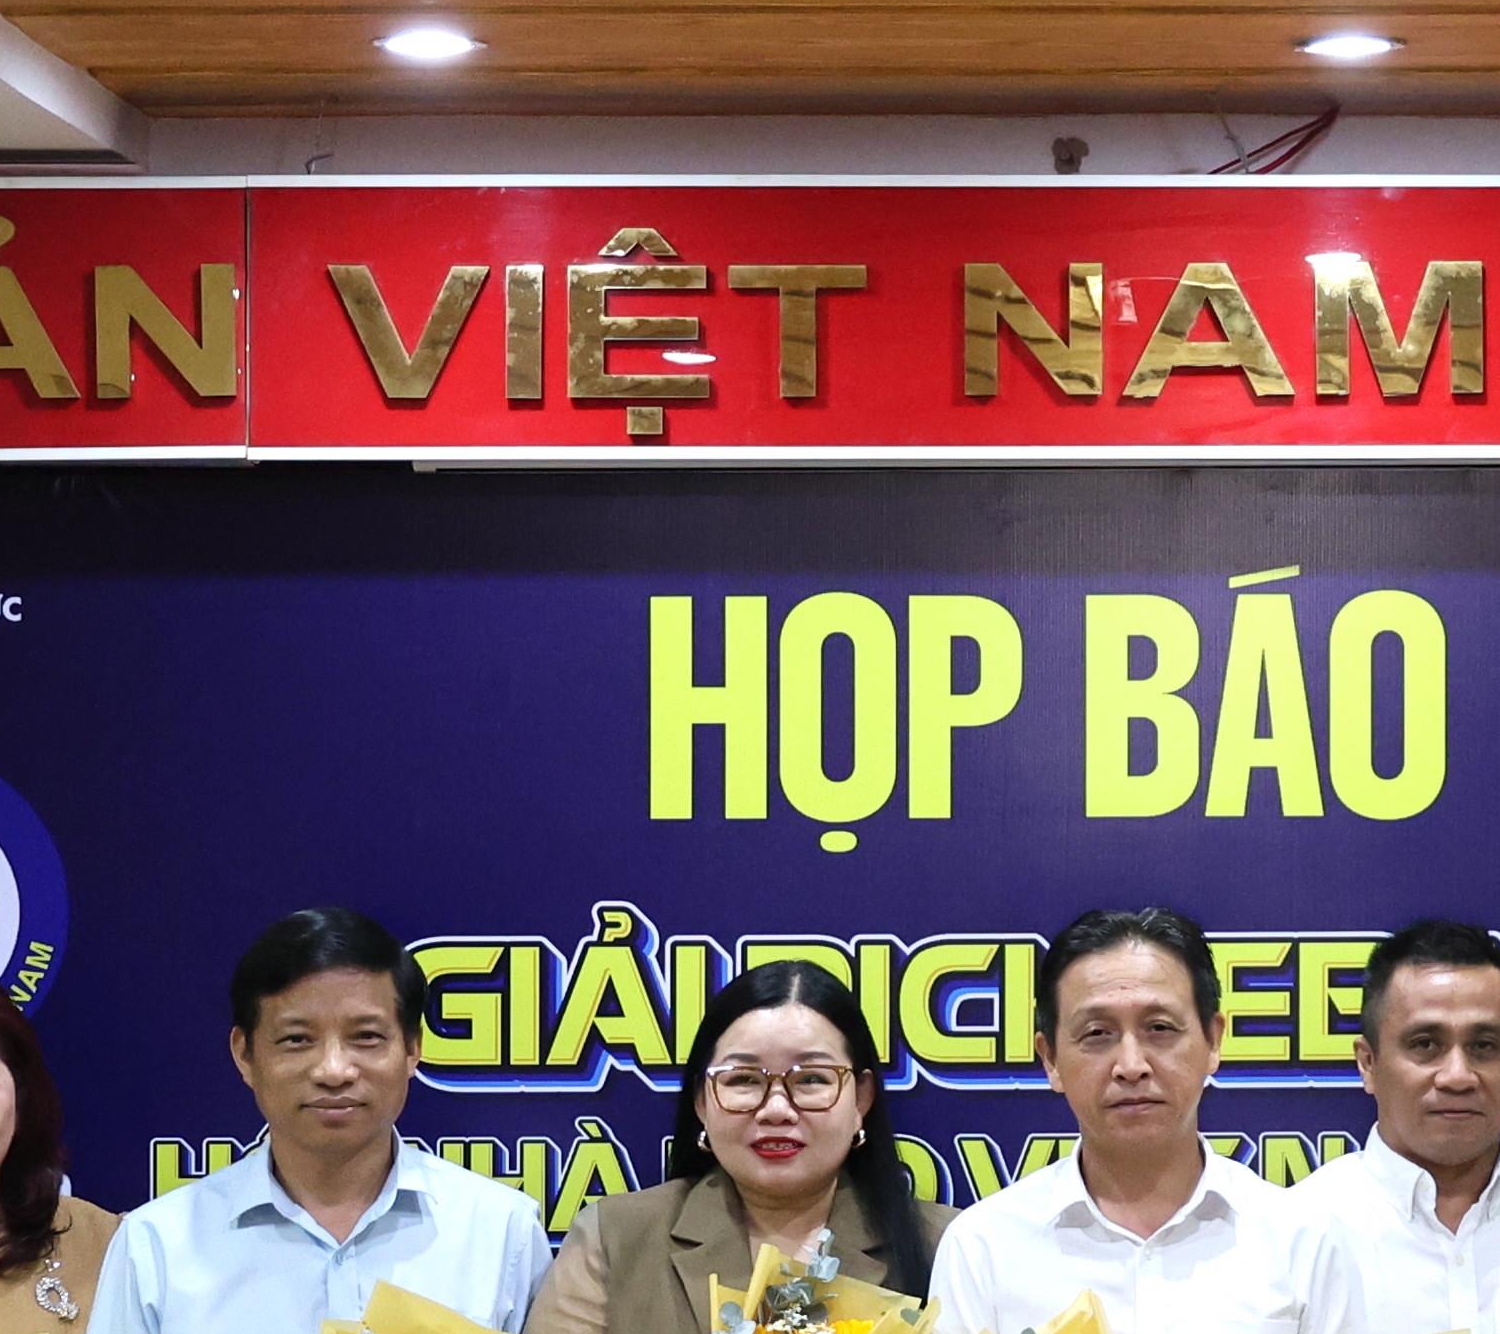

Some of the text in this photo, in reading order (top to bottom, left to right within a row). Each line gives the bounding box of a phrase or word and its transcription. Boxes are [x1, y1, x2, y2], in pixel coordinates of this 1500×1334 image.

[327, 228, 867, 435] VIỆT
[963, 261, 1484, 398] NAM
[650, 564, 1447, 852] HỌP BÁO
